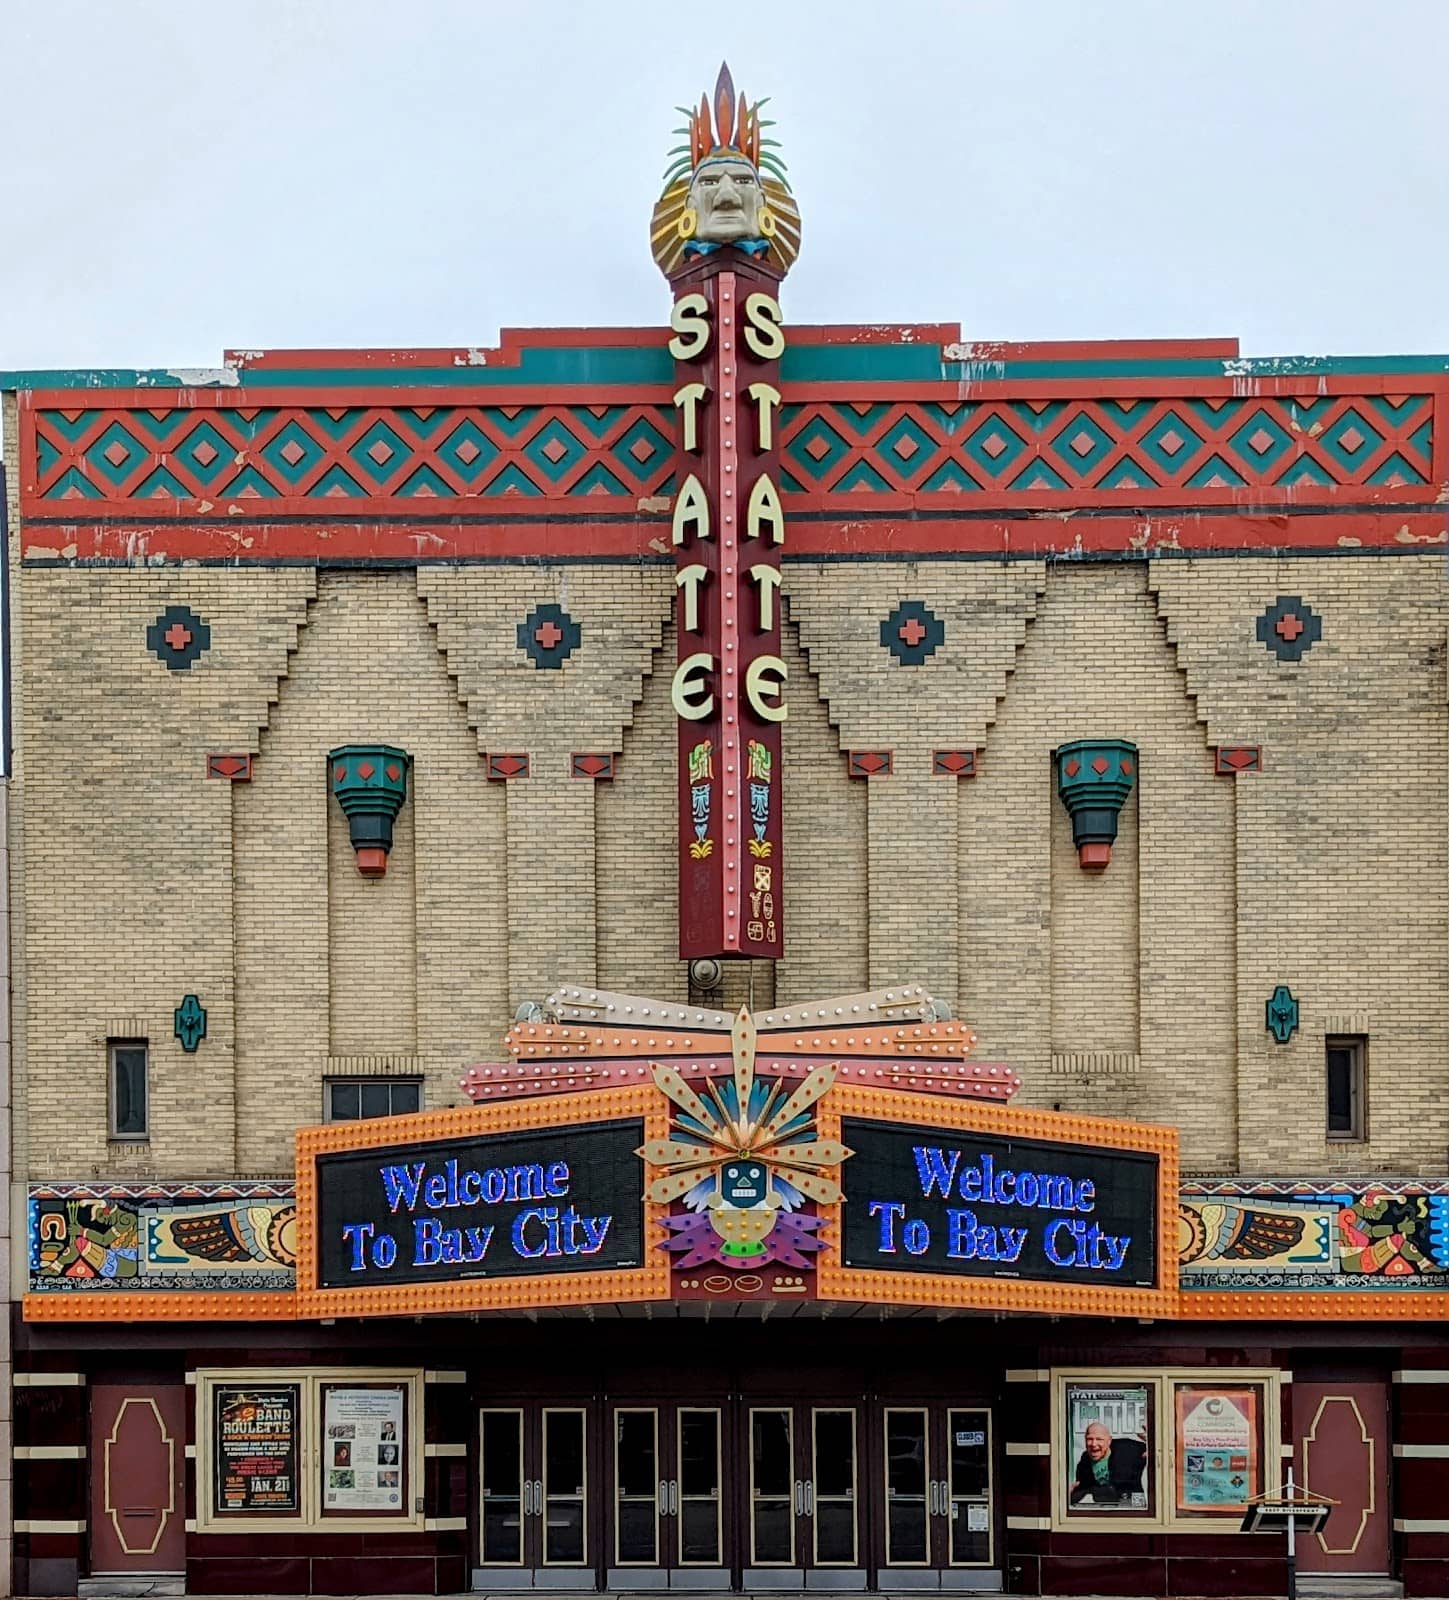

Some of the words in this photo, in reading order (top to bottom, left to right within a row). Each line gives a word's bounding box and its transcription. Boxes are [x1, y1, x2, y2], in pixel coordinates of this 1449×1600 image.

[668, 293, 714, 721] STATE
[744, 292, 788, 722] STATE
[380, 1158, 570, 1213] Welcome
[912, 1146, 1096, 1213] Welcome
[342, 1222, 397, 1271] To
[412, 1217, 495, 1267] Bay
[511, 1205, 613, 1259] City
[868, 1201, 930, 1255] To
[946, 1208, 1028, 1263] Bay
[1044, 1218, 1131, 1270] City
[223, 1422, 291, 1434] ROULETTE
[256, 1409, 291, 1421] BAND
[251, 1480, 273, 1492] JAN.
